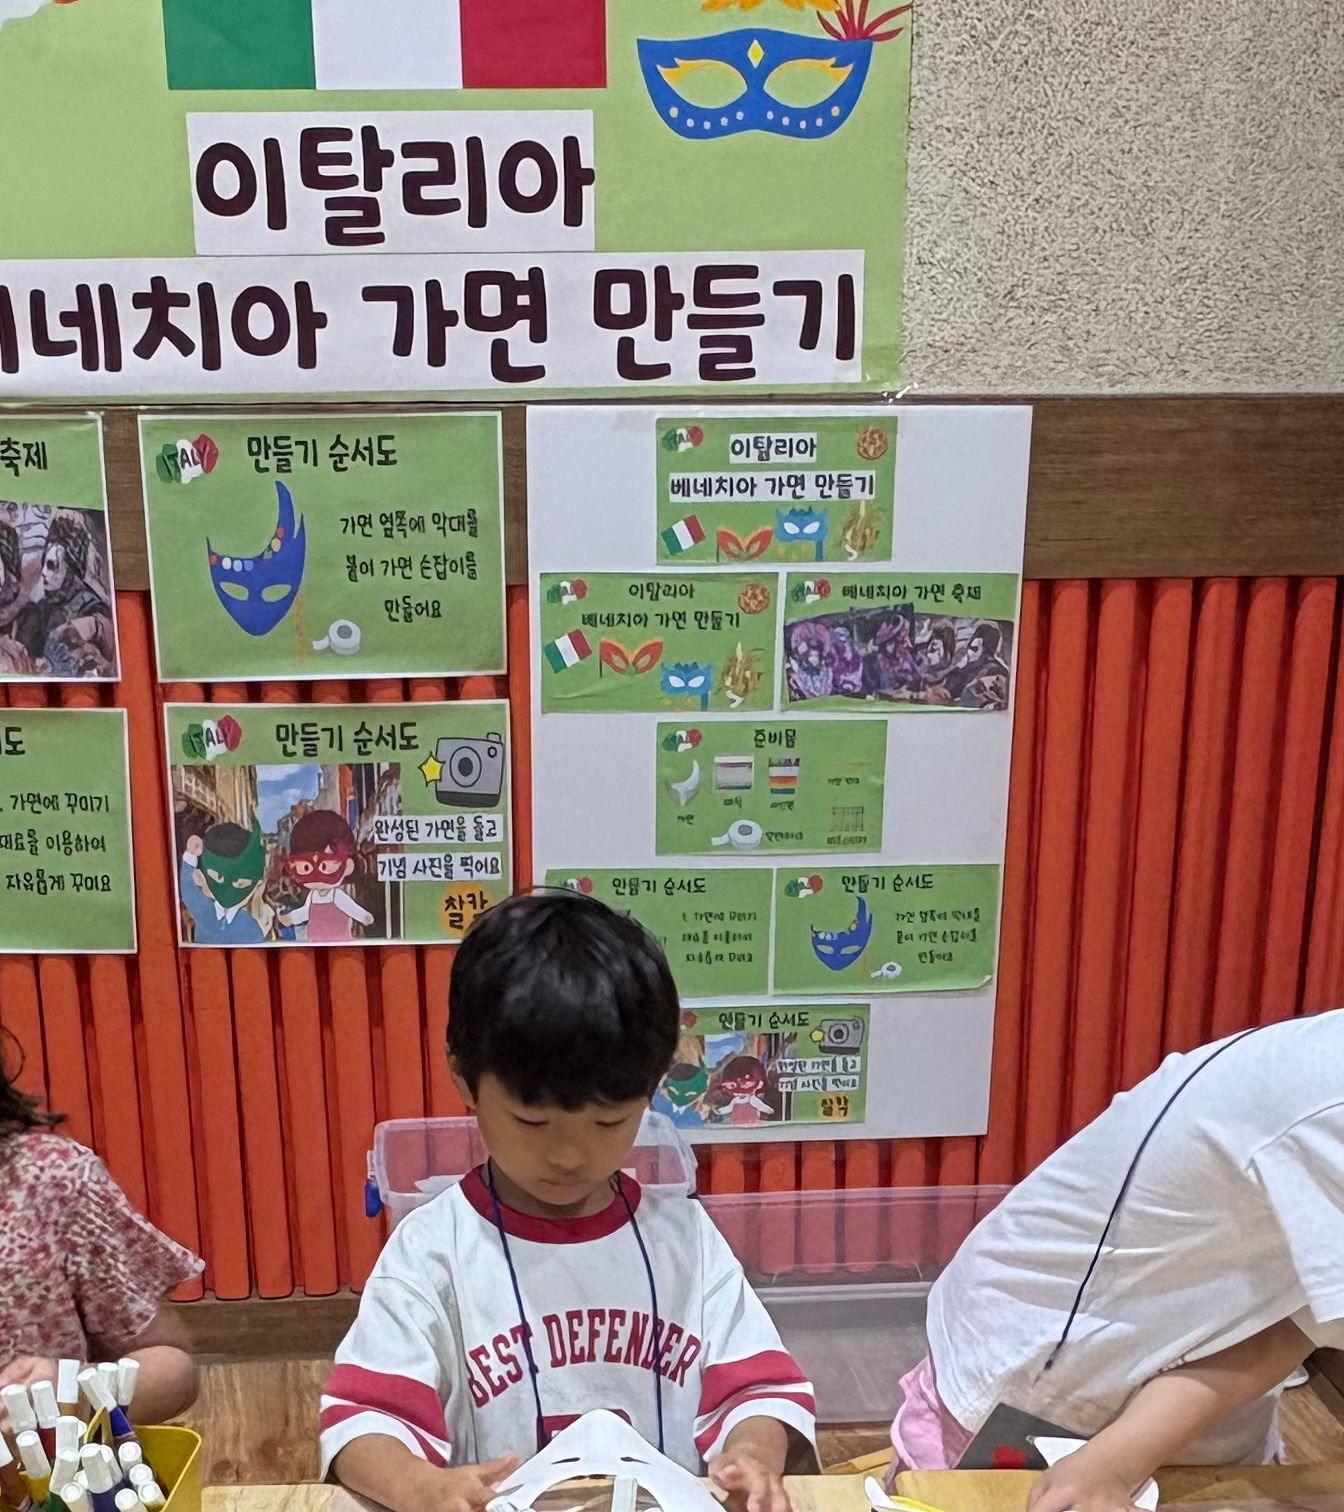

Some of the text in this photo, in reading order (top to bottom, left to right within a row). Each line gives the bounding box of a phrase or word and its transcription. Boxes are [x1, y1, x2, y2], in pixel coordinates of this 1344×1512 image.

[194, 124, 595, 247] 이탈리아
[362, 266, 550, 384] 가면
[593, 263, 856, 383] 만들기
[0, 436, 49, 478] 축제
[247, 433, 398, 474] 만들기 순서도
[730, 435, 817, 462] 이탈리아
[670, 473, 875, 500] 베네치아 가면 만들기
[379, 555, 413, 581] 가면
[275, 720, 420, 758] 만들기 순서도
[9, 792, 61, 815] 가면에
[64, 792, 110, 814] 꾸미기
[46, 829, 107, 857] 이용하여
[374, 818, 419, 843] 완성된
[473, 815, 498, 843] 들고
[378, 856, 407, 880] 기념
[412, 853, 454, 881] 사진을
[467, 1308, 702, 1408] BEST DEFENDER
